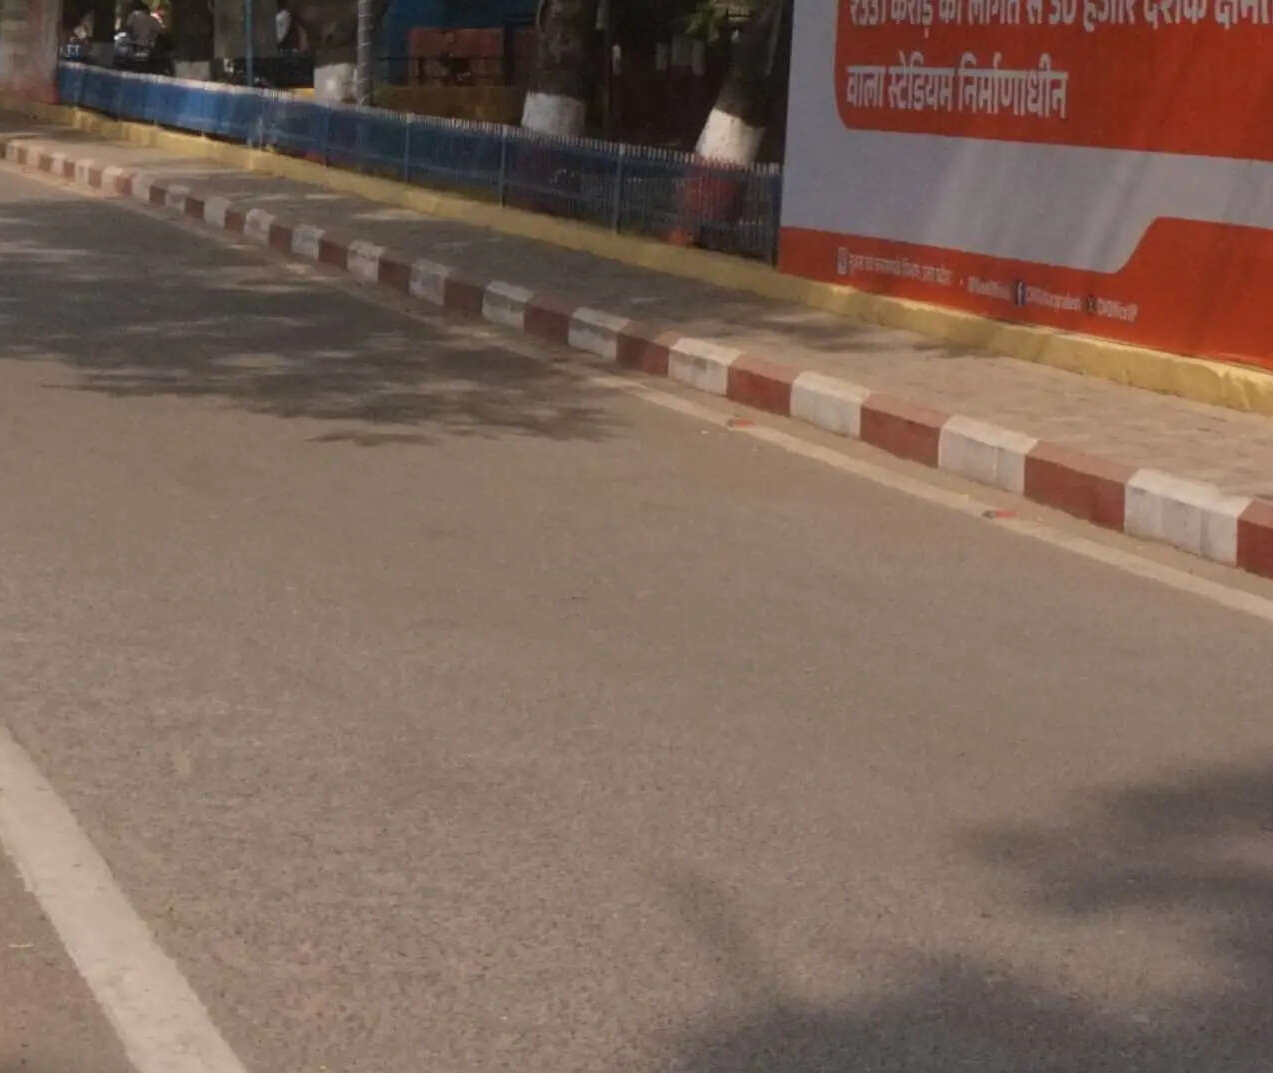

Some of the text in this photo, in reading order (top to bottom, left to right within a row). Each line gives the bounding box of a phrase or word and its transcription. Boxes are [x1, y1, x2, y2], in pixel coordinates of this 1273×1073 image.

[846, 50, 1069, 118] वाला स्टेडियम निर्माणाधीन
